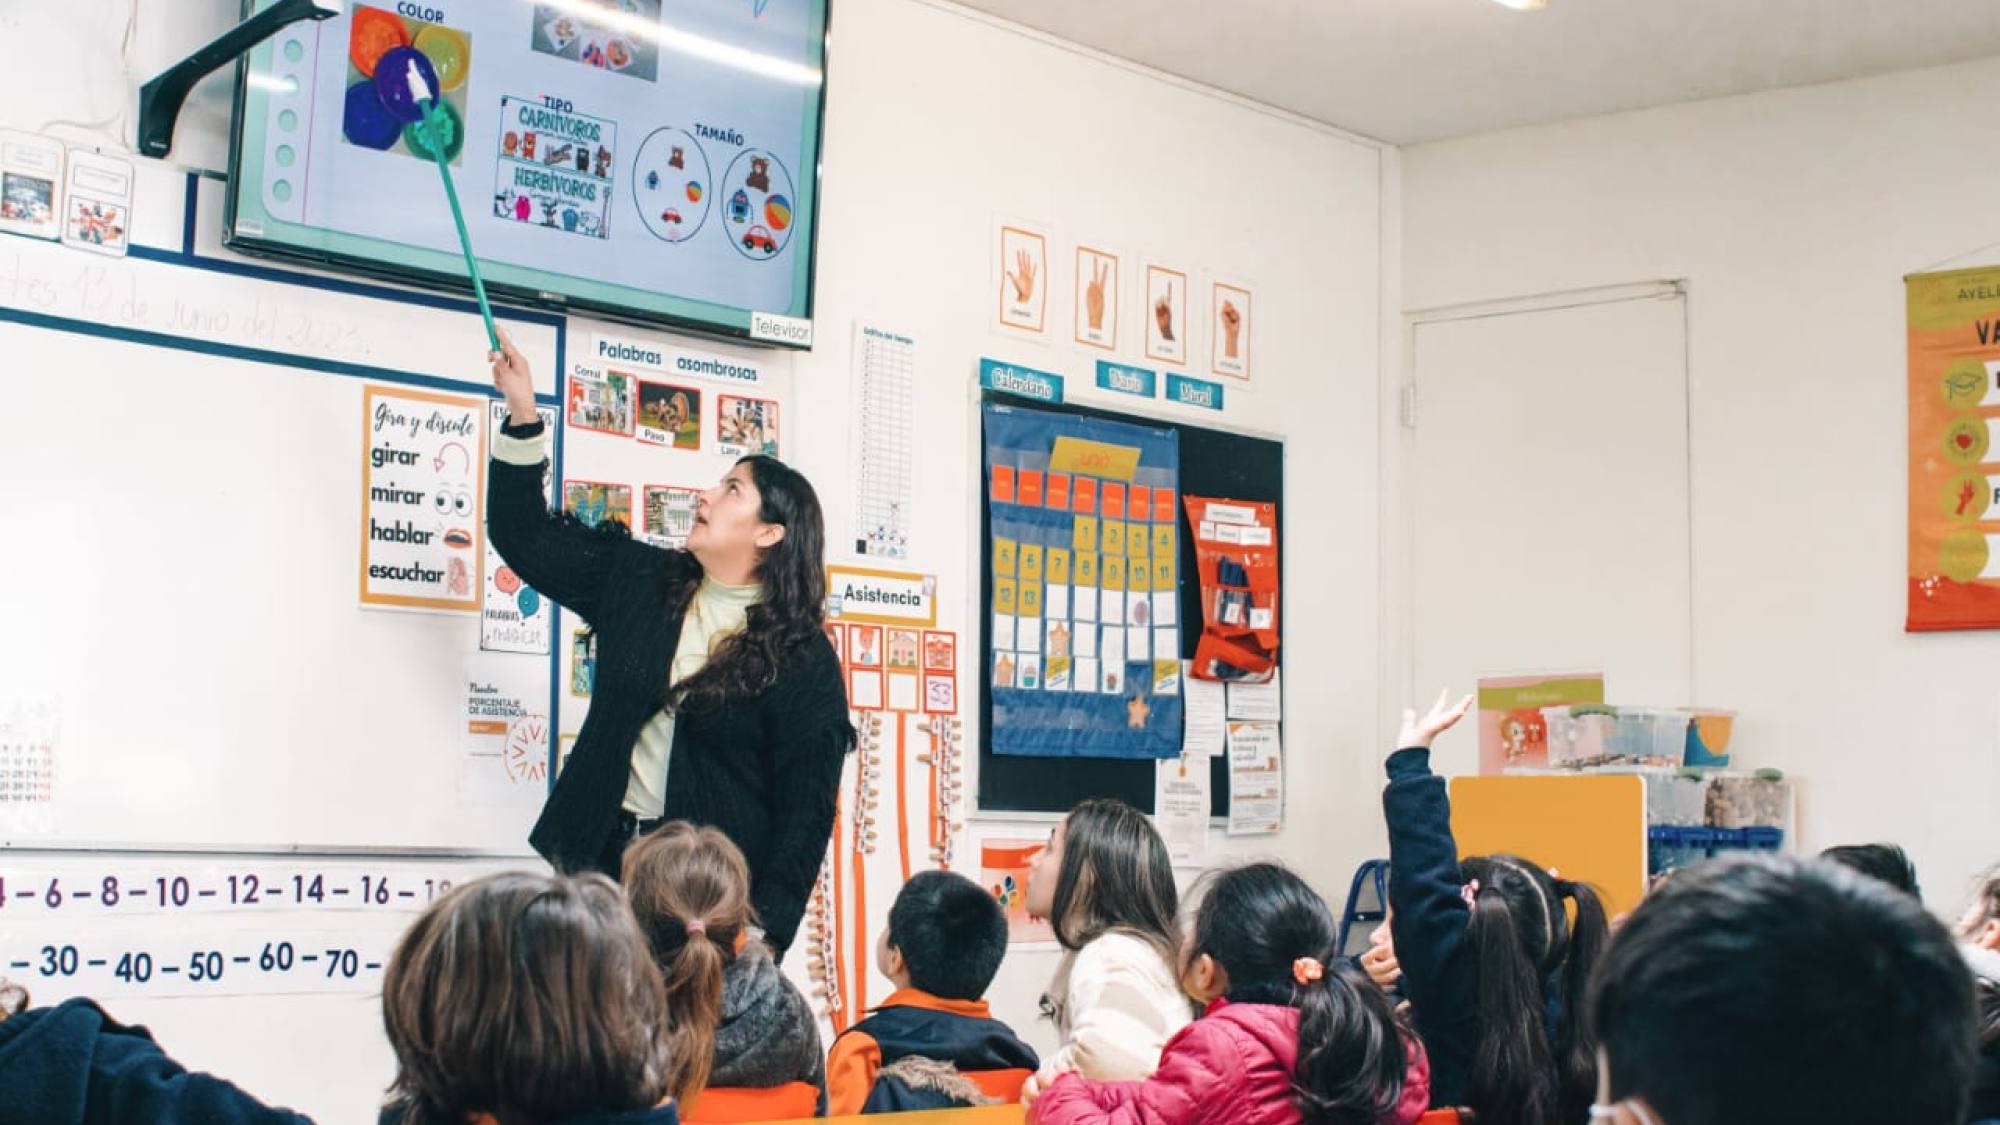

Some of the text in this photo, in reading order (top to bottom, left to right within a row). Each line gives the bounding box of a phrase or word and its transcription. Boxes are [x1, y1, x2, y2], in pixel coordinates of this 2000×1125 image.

[397, 1, 444, 23] COLOR
[544, 95, 573, 113] TIPO
[695, 124, 744, 146] TAMAÑO
[119, 272, 149, 321] de
[755, 317, 809, 340] Televisor
[600, 341, 757, 381] Palabras asombrosas
[375, 403, 406, 432] Gira
[409, 416, 422, 438] y
[426, 411, 475, 435] discute
[371, 441, 420, 468] girar
[371, 481, 425, 505] mirar
[370, 518, 434, 546] hablar
[369, 561, 445, 584] escuchar
[844, 583, 921, 606] Asistencia
[469, 697, 520, 708] PORCENTAJE
[469, 706, 480, 715] DE
[45, 878, 62, 908] 6
[101, 876, 119, 906] 8
[156, 876, 189, 907] 10
[227, 874, 260, 904] 12
[293, 873, 325, 904] 14
[361, 875, 389, 905] 16
[39, 941, 358, 983] 30 40 50 60 70
